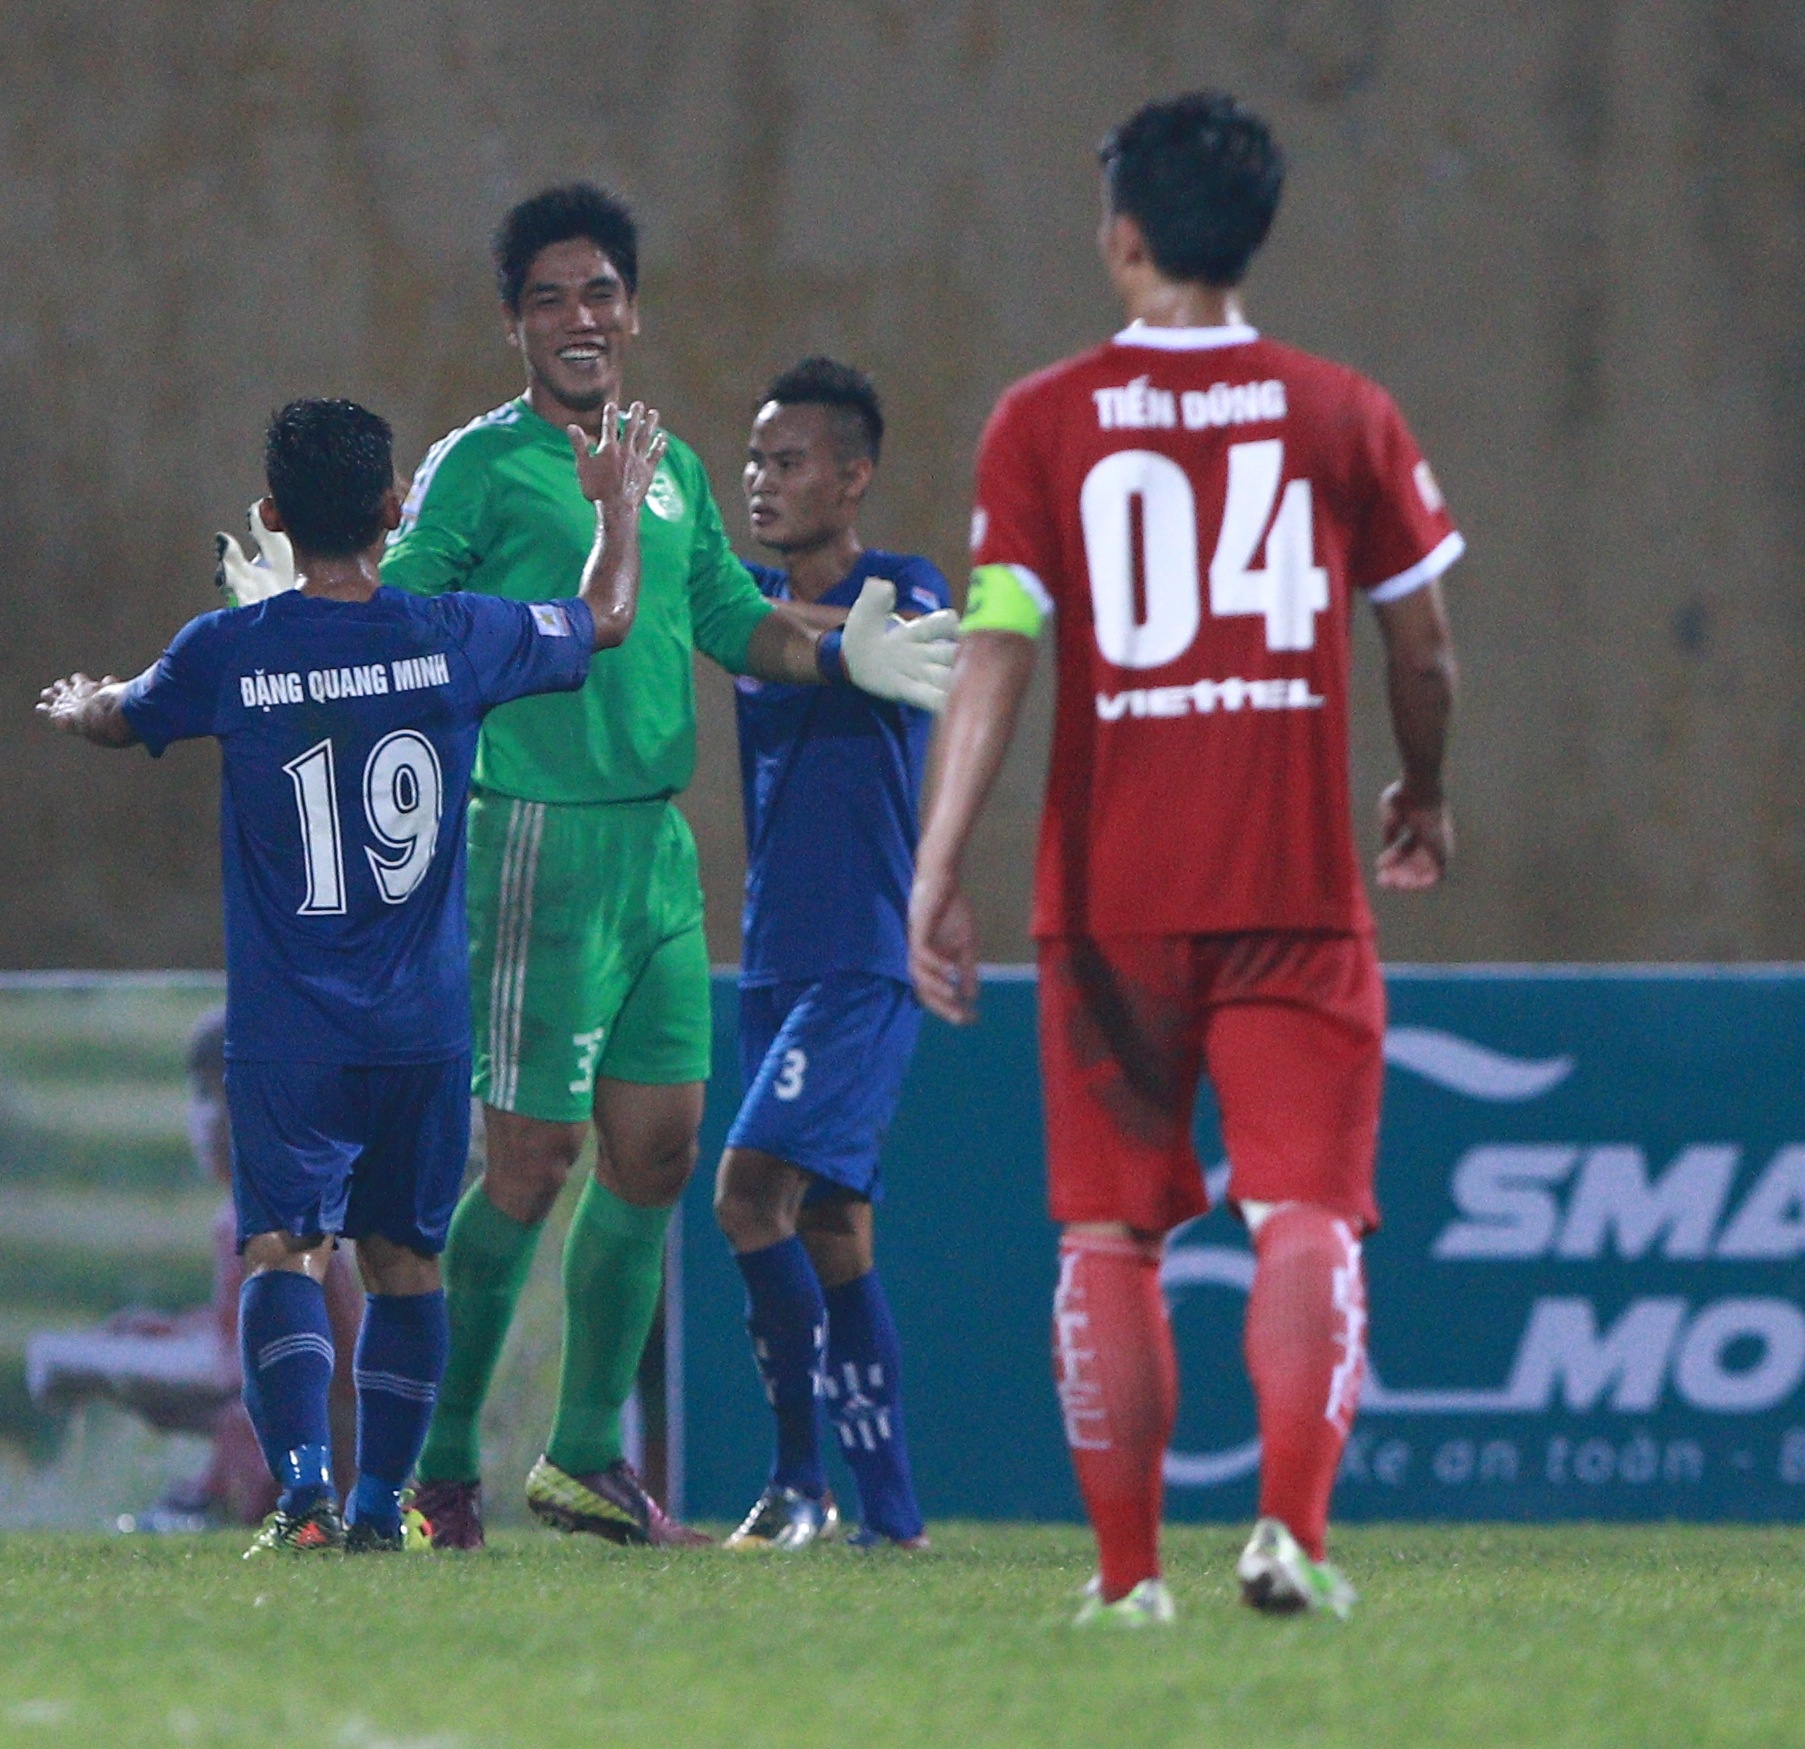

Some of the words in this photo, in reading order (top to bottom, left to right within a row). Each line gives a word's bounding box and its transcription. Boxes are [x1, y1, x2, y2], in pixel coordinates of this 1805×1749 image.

[1080, 438, 1330, 669] 04
[240, 668, 304, 713] ĐẶNG
[308, 663, 388, 704] QUANG
[391, 653, 450, 692] MINH
[282, 729, 443, 915] 19
[774, 1049, 808, 1100] 3
[1433, 1440, 1520, 1484] an
